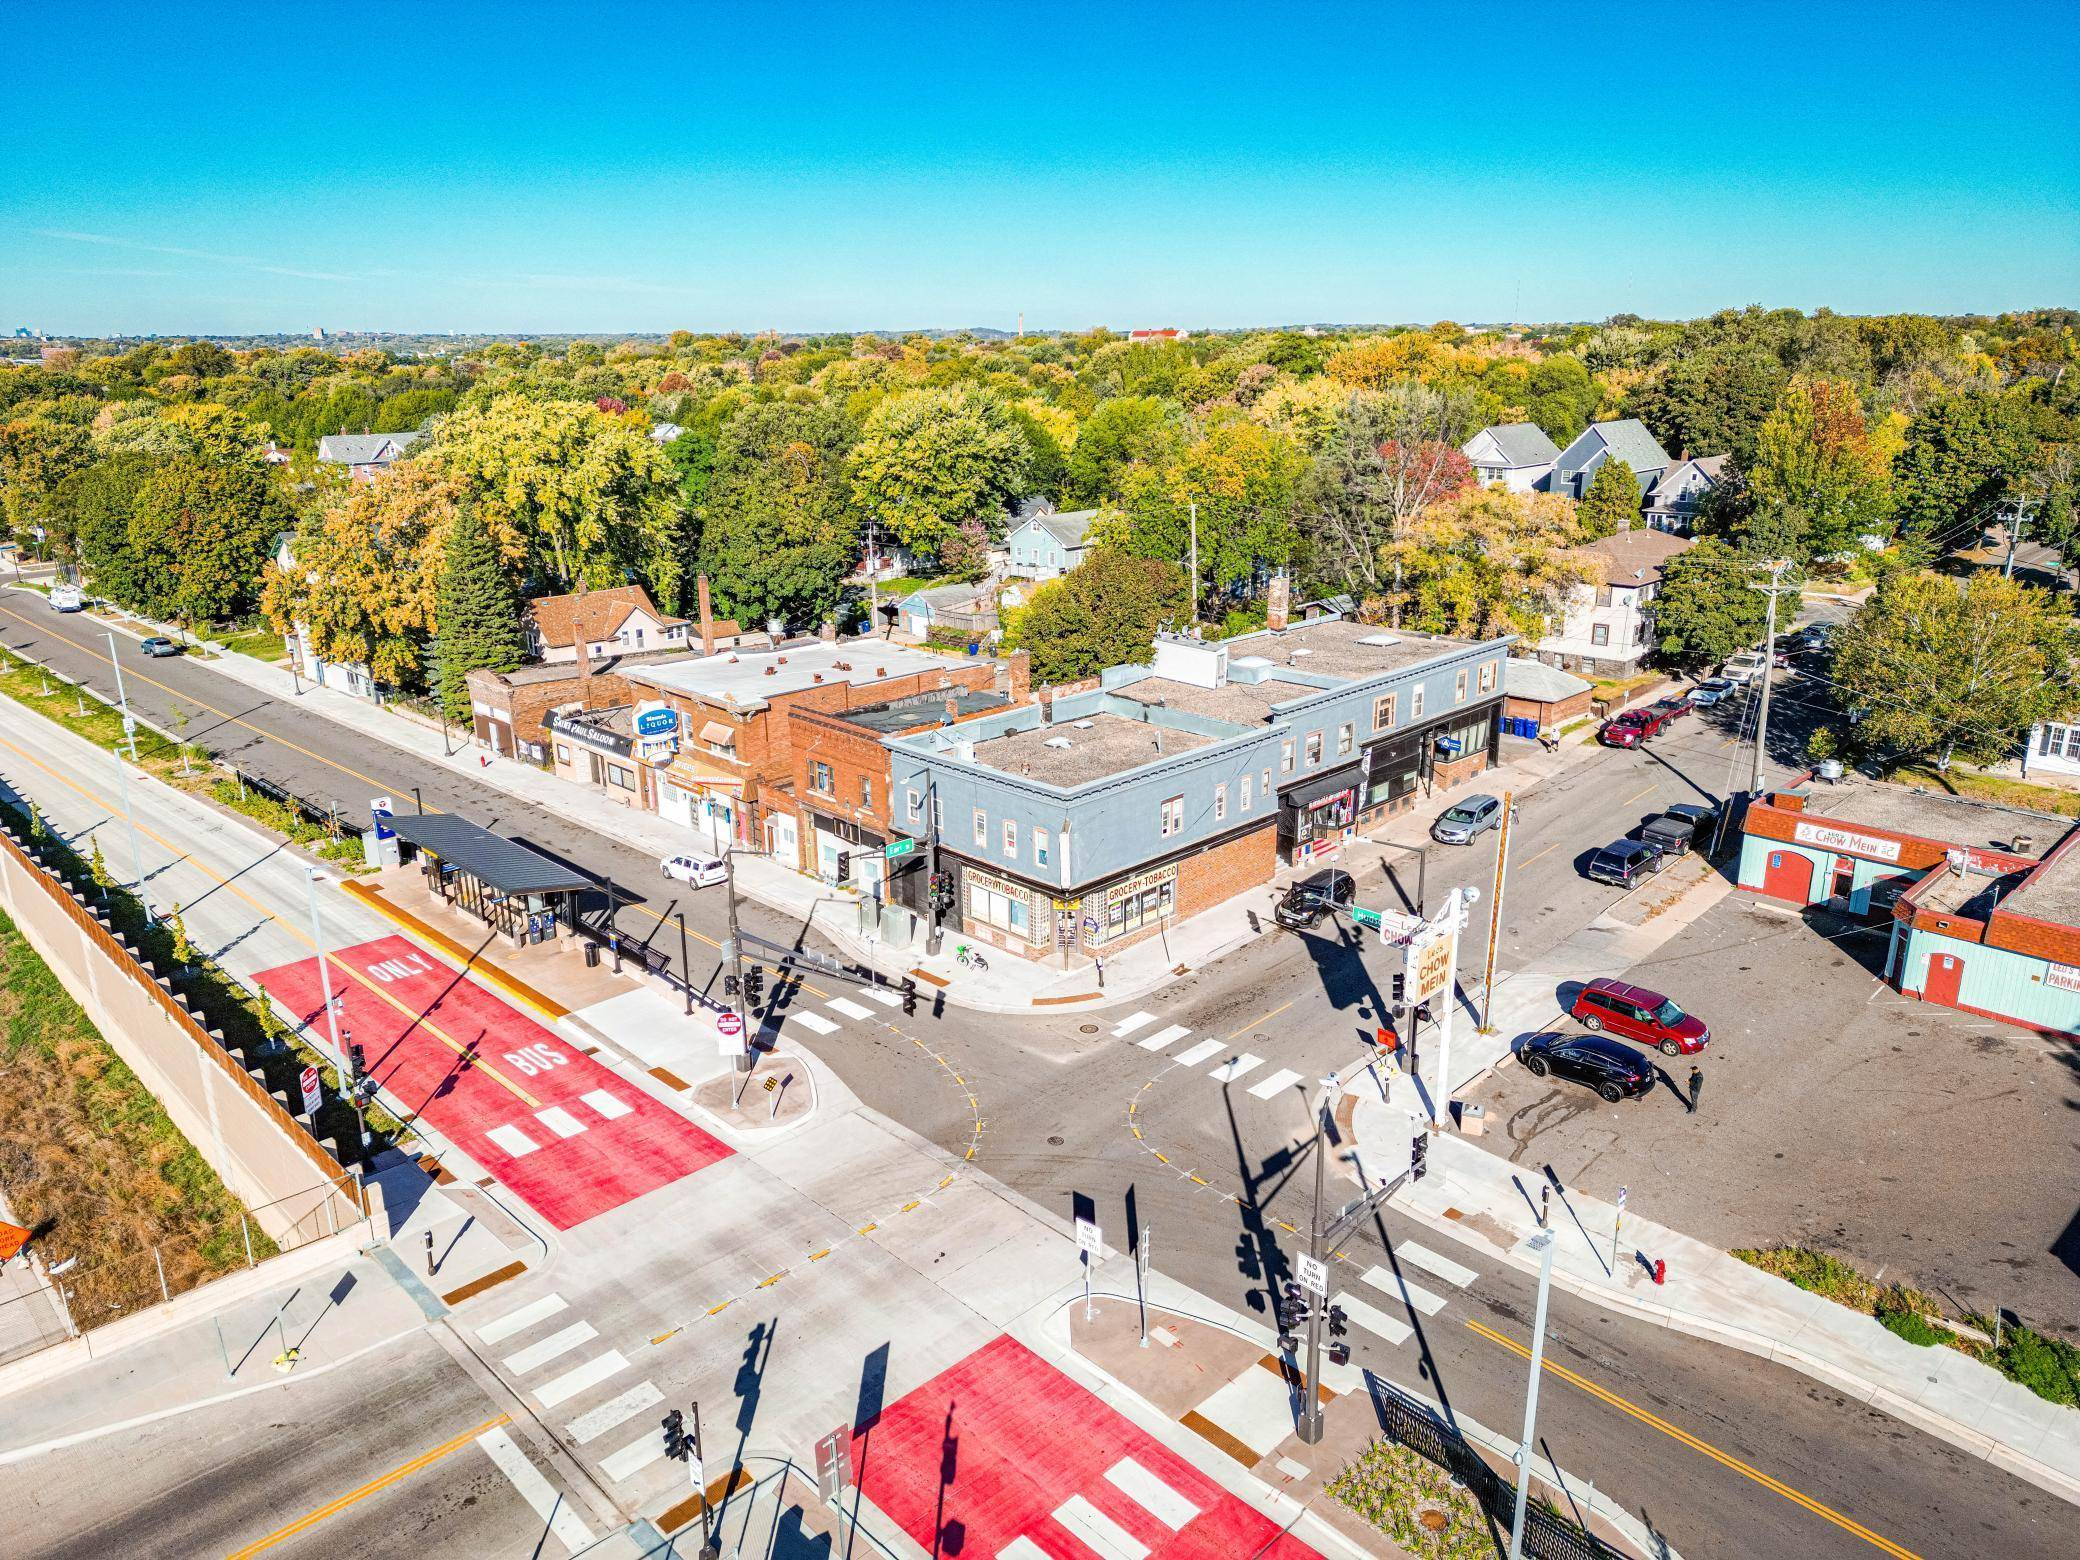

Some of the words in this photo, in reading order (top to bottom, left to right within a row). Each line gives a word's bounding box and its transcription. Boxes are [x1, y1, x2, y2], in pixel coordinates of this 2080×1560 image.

[552, 716, 571, 731] SAINT
[570, 725, 588, 738] PAUL
[588, 728, 616, 746] SALOON
[640, 718, 674, 730] LIQUOR
[1815, 829, 1847, 847] CHOW
[1848, 836, 1878, 854] MEIN
[1109, 865, 1176, 901] GROCERY-TOBACCO
[1383, 928, 1413, 946] CHOW
[366, 952, 435, 983] ONLY
[1418, 951, 1450, 980] CHOW
[1420, 972, 1446, 997] MEIN
[502, 1042, 570, 1077] BUS
[0, 1240, 20, 1249] HEAD
[1303, 1267, 1321, 1281] TURN
[1306, 1260, 1318, 1271] NO
[1298, 1274, 1308, 1284] ON
[1310, 1281, 1324, 1292] RED
